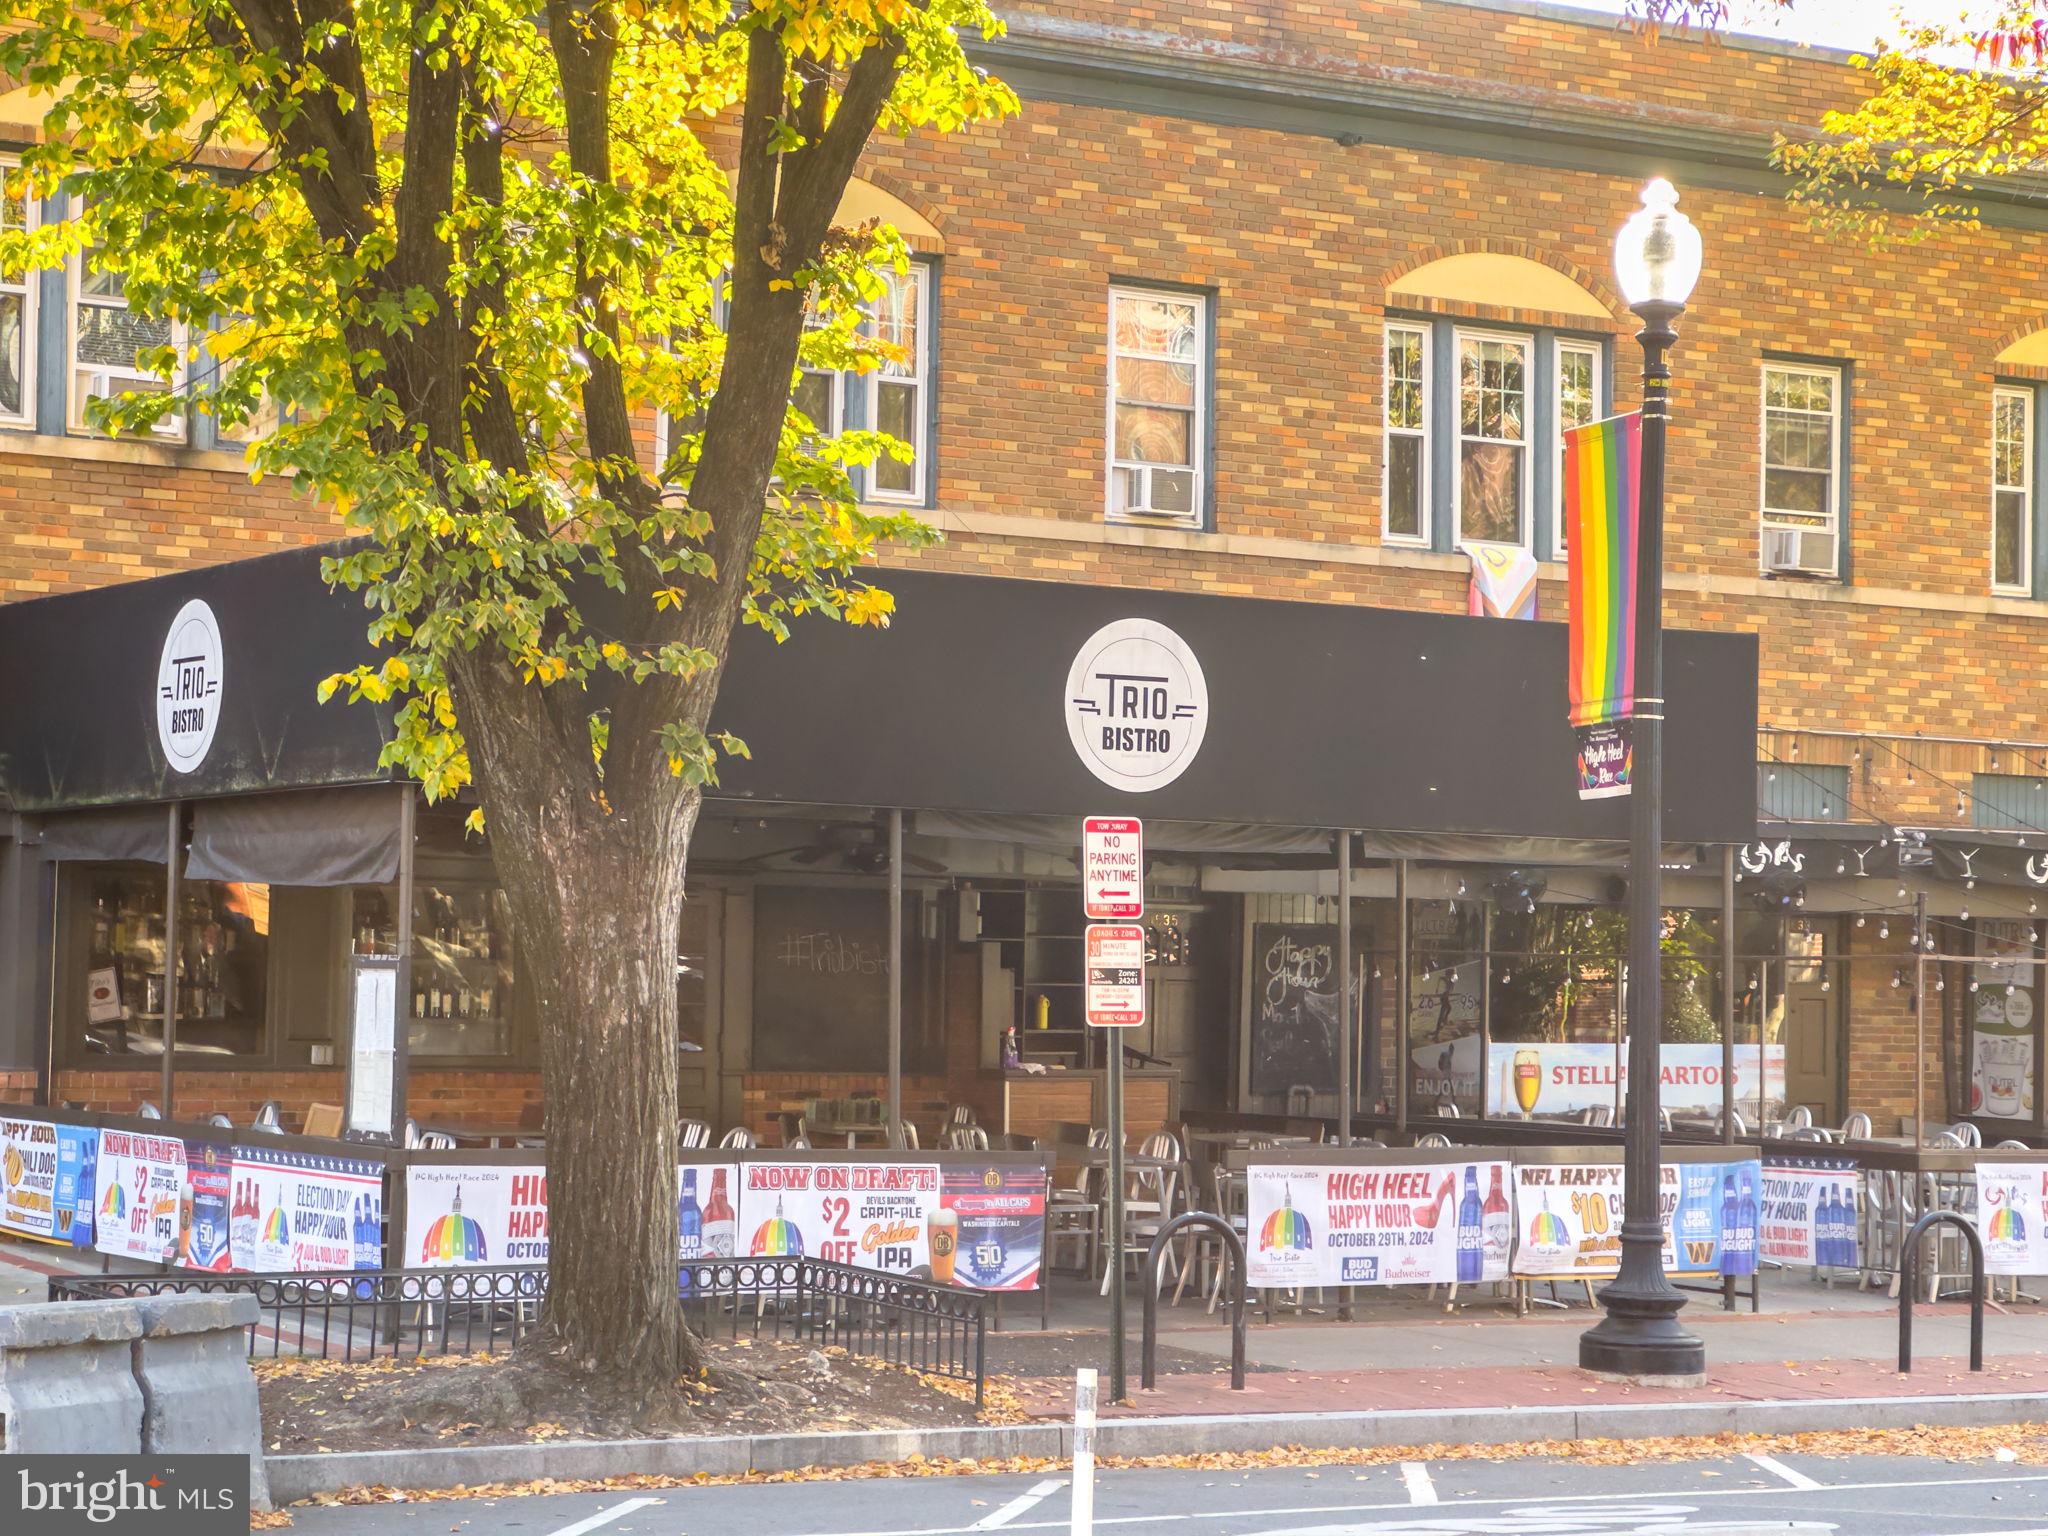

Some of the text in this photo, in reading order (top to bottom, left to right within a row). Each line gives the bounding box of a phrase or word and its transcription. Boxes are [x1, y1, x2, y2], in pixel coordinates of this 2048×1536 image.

[172, 656, 206, 701] TRIO
[1096, 673, 1169, 720] TRIO
[171, 708, 205, 734] BISTRO
[1102, 727, 1171, 754] BISTRO
[1104, 836, 1120, 848] NO
[1089, 853, 1136, 865] PARKING
[1089, 870, 1138, 882] ANYTIME
[1090, 941, 1101, 956] 30
[1118, 977, 1138, 985] 24241
[1415, 1078, 1476, 1096] ENJOY IT
[104, 1131, 131, 1157] NOW
[132, 1135, 147, 1159] ON
[38, 1151, 56, 1175] DOG
[427, 1173, 444, 1183] High
[463, 1173, 480, 1182] Race
[748, 1166, 937, 1191] NOW ON DRAFT!
[1327, 1172, 1432, 1200] HIGH HEEL
[1521, 1168, 1622, 1186] NFL HAPPY
[297, 1184, 353, 1213] ELECTION DAY
[1791, 1181, 1814, 1199] DAY
[131, 1206, 148, 1235] OFF
[822, 1196, 850, 1237] $2
[866, 1197, 886, 1205] DEVILS
[860, 1206, 922, 1219] CAPIT-ALE
[1328, 1203, 1412, 1229] HAPPY HOUR
[1571, 1191, 1609, 1235] $10
[1775, 1202, 1807, 1221] HOUR
[155, 1217, 172, 1239] IPA
[200, 1223, 213, 1243] 50
[294, 1210, 348, 1241] HAPPY HOUR
[1459, 1225, 1481, 1237] BUD
[1735, 1228, 1754, 1239] BUD
[1773, 1226, 1787, 1240] BUD
[1788, 1227, 1808, 1242] LIGHT
[679, 1235, 700, 1249] UD
[861, 1220, 920, 1254] Golden
[1328, 1233, 1376, 1247] OCTOBER
[1409, 1231, 1434, 1246] 2024
[1458, 1237, 1484, 1249] IGHT
[506, 1242, 549, 1259] OCTOB
[821, 1241, 1002, 1268] OFF IPA 50
[1348, 1259, 1372, 1269] BUD
[1343, 1269, 1432, 1280] LIGHT Budweiser
